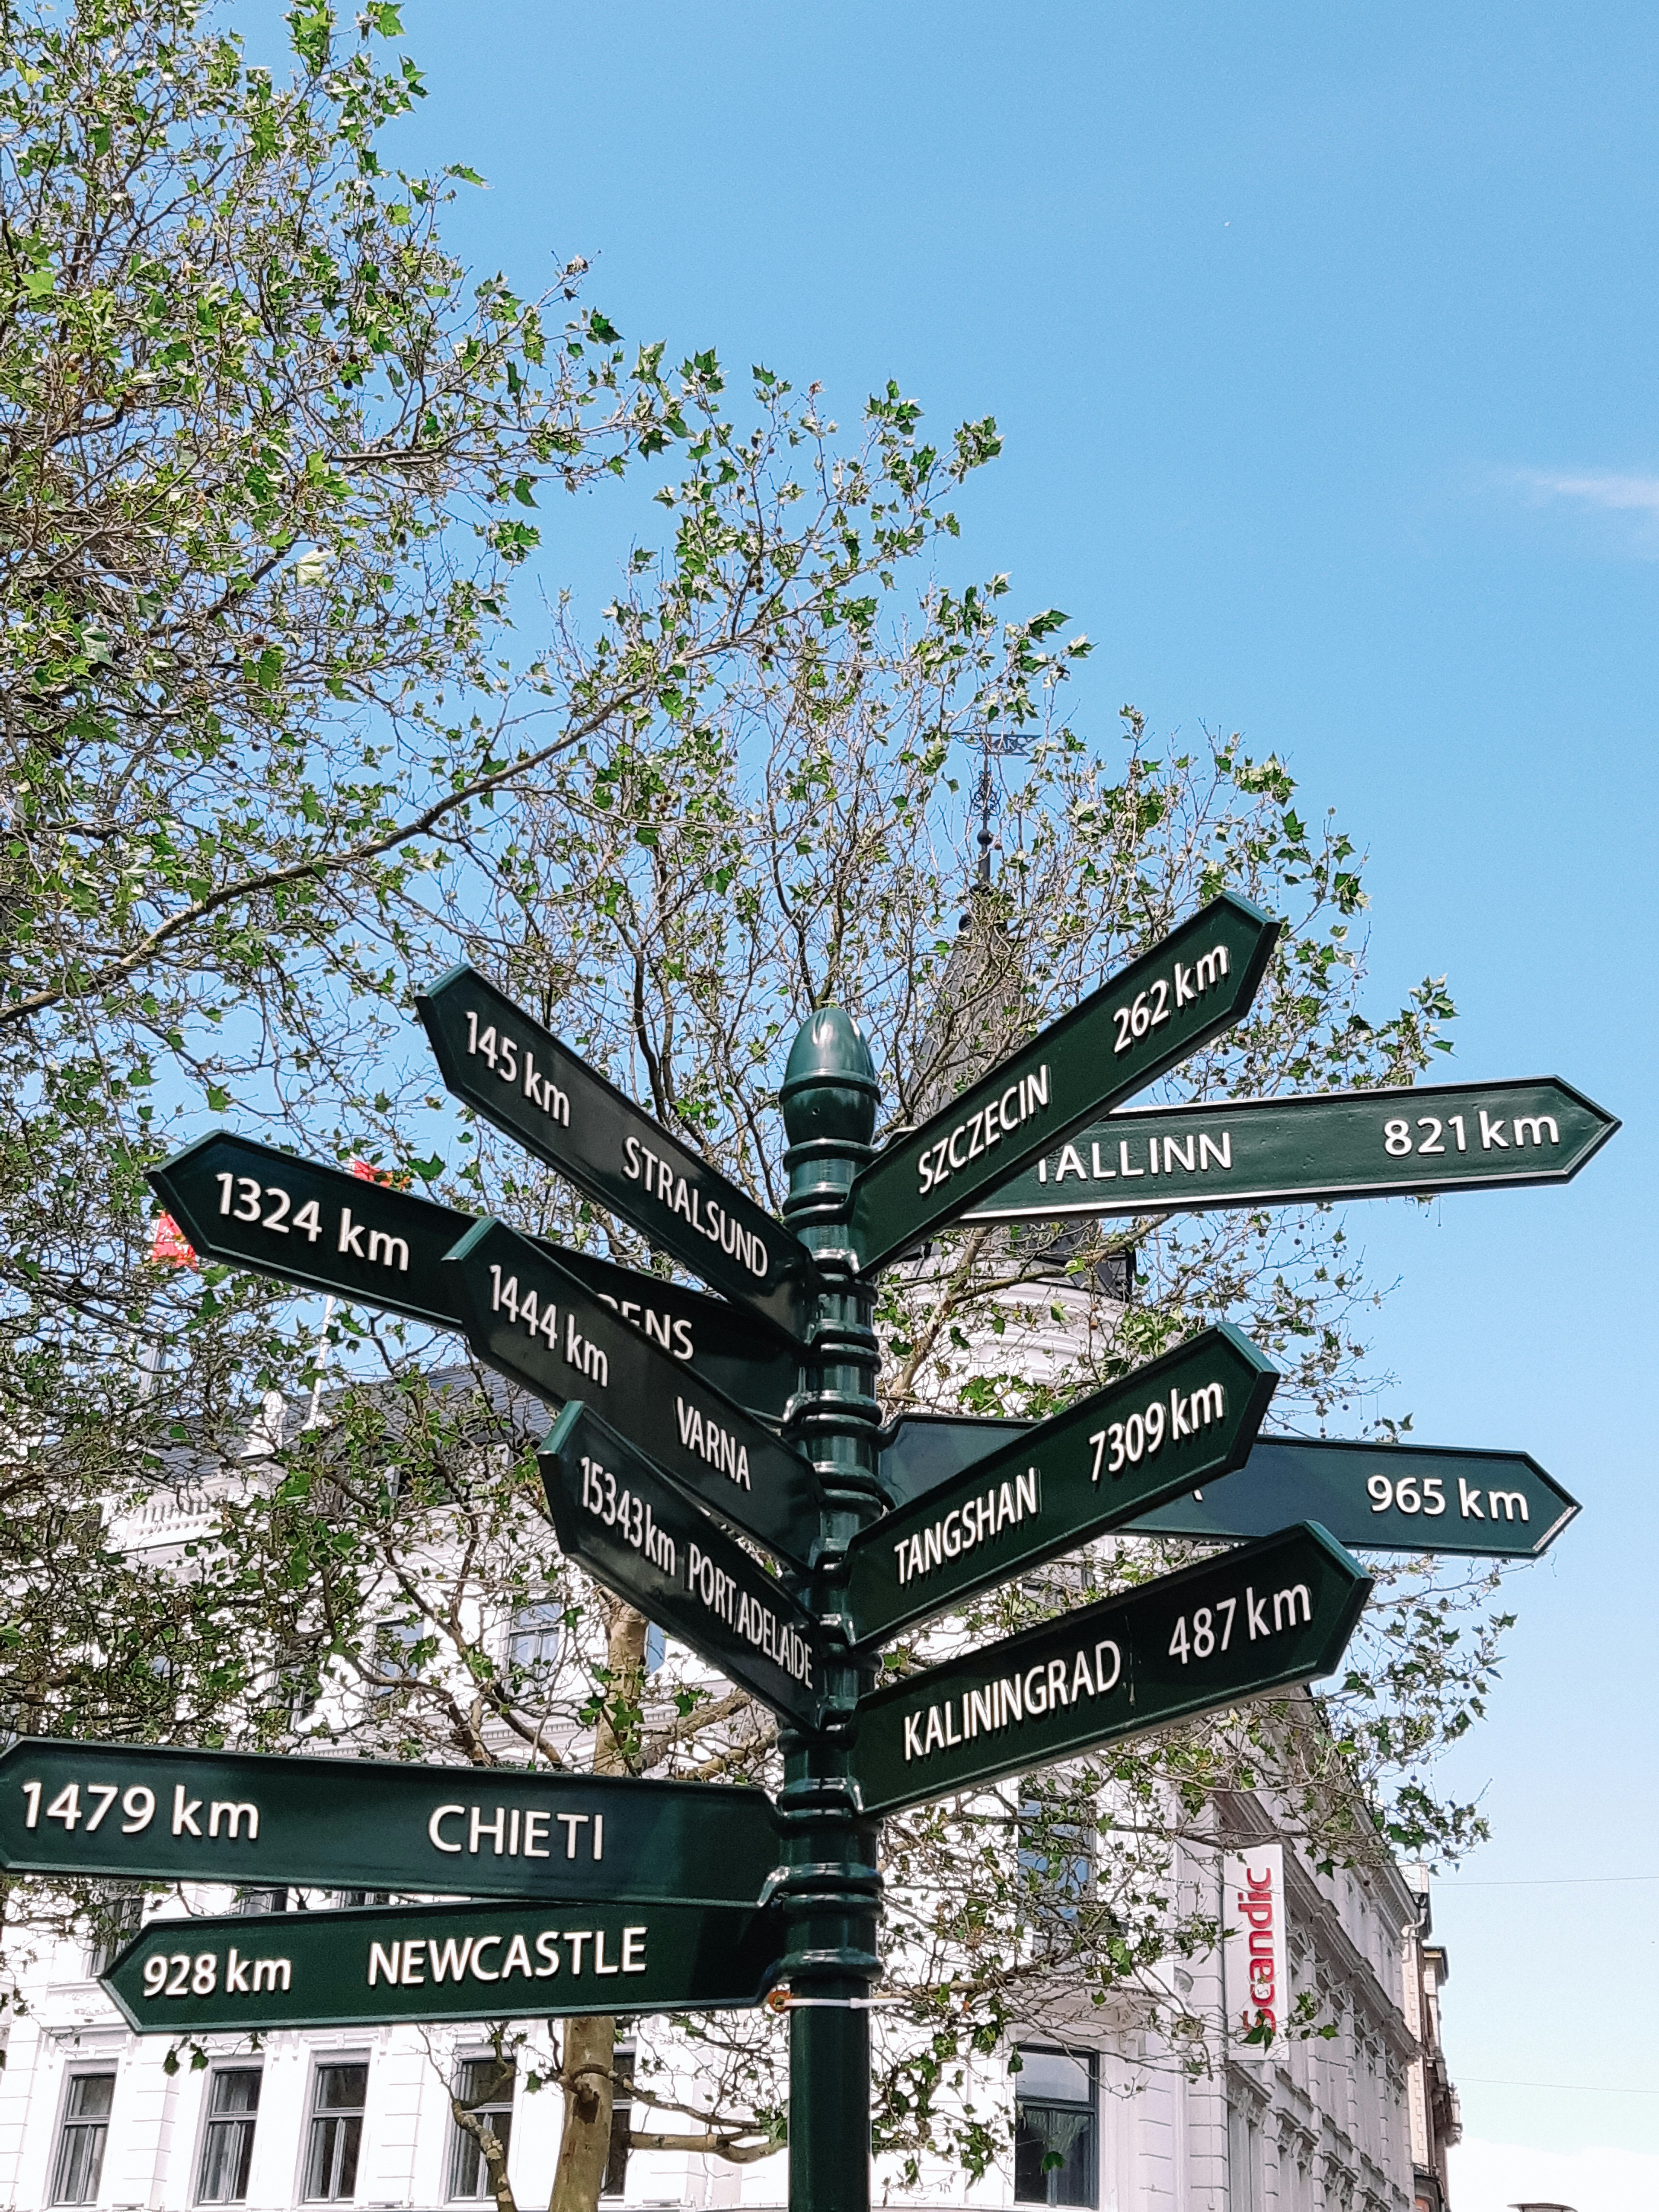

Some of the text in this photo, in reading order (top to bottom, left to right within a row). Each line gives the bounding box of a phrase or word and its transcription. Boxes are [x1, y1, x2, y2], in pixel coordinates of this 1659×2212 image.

[466, 1011, 768, 1277] 145 km STRALSUND
[918, 945, 1228, 1194] SZCZECIN 262 km
[1384, 1114, 1467, 1157] 821
[1478, 1110, 1559, 1149] km
[216, 1172, 322, 1242] 1324
[338, 1208, 409, 1271] km
[490, 1264, 751, 1491] 1444 km VARNA
[894, 1382, 1223, 1584] TANGSHAN 7309 km
[1367, 1475, 1529, 1521] 965 km
[581, 1456, 813, 1689] 15343 km PORT ADELAIDE
[904, 1584, 1311, 1760] KALININGRAD 487 km
[22, 1781, 603, 1860] 1479 km CHIETI
[143, 1926, 648, 1996] 928 km NEWCASTLE
